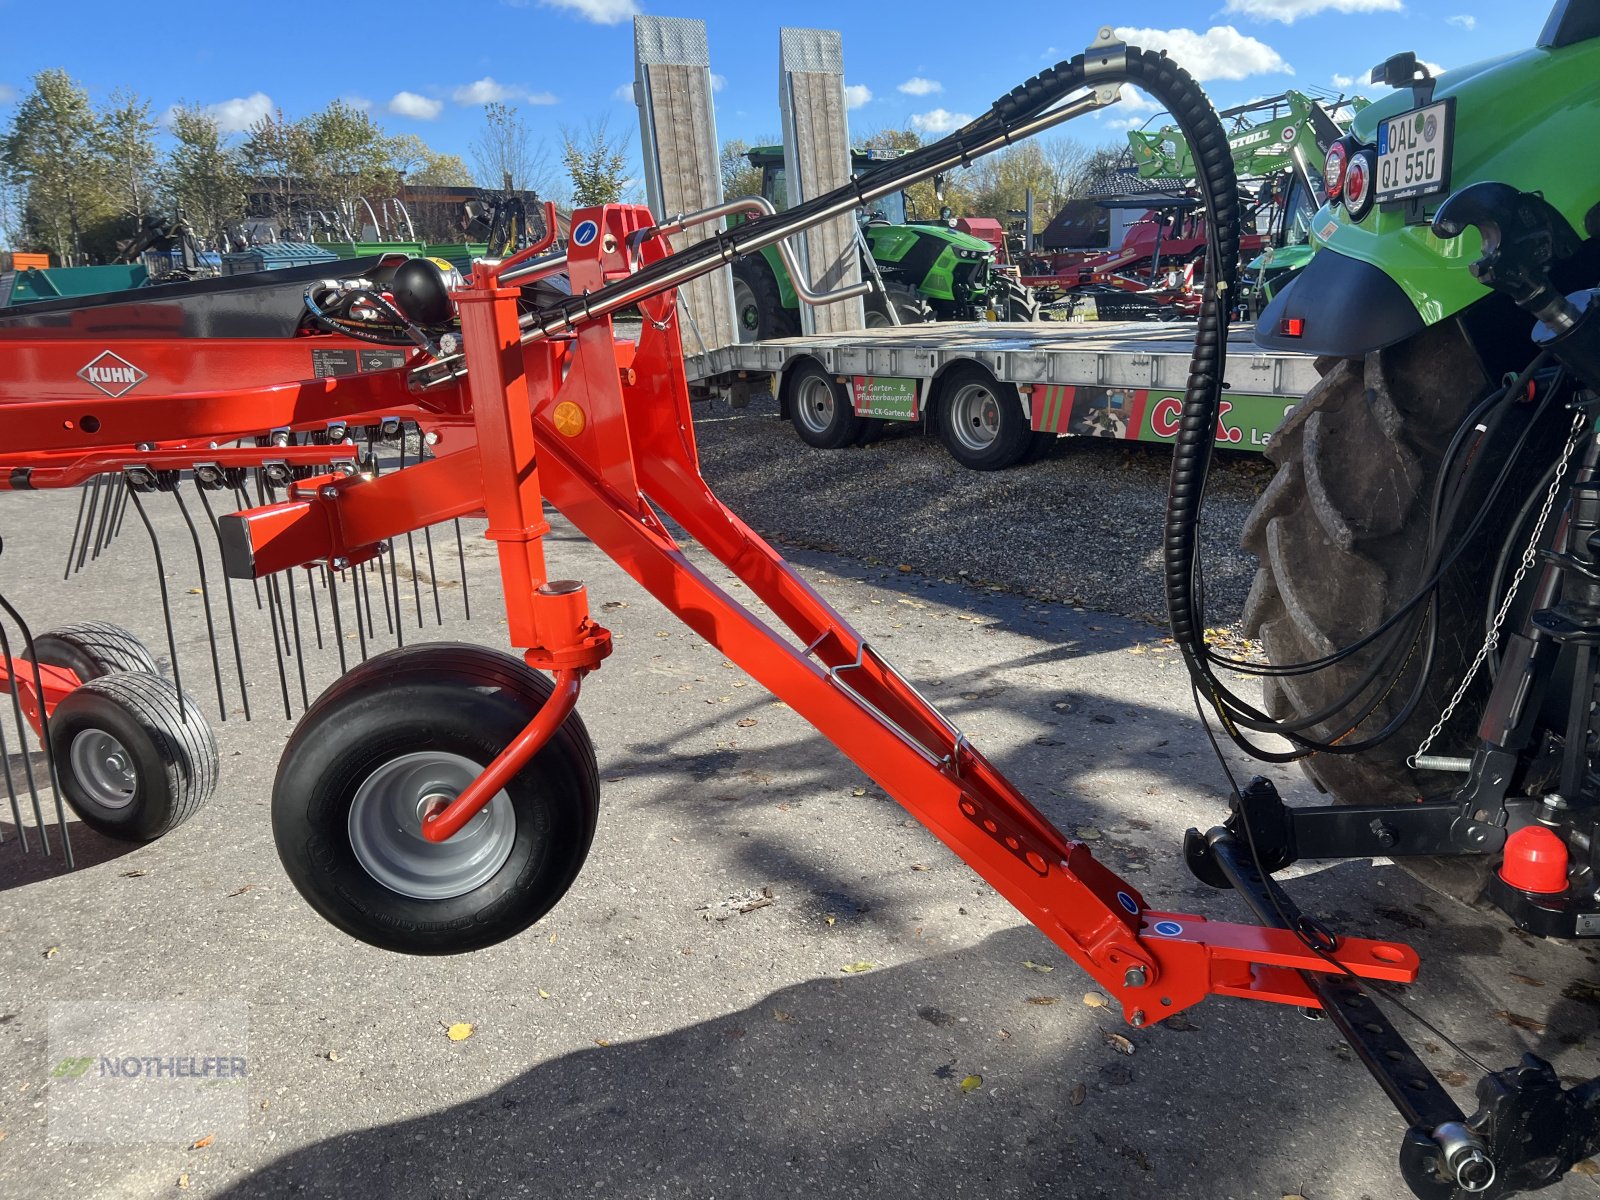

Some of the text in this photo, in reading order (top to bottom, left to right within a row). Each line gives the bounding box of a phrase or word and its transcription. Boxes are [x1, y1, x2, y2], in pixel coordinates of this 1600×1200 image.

[1228, 129, 1271, 150] STOLL
[1388, 119, 1417, 154] OAL
[1382, 147, 1436, 189] QI 550
[88, 367, 136, 383] KUHN
[857, 408, 914, 417] www.CK-Garten.de
